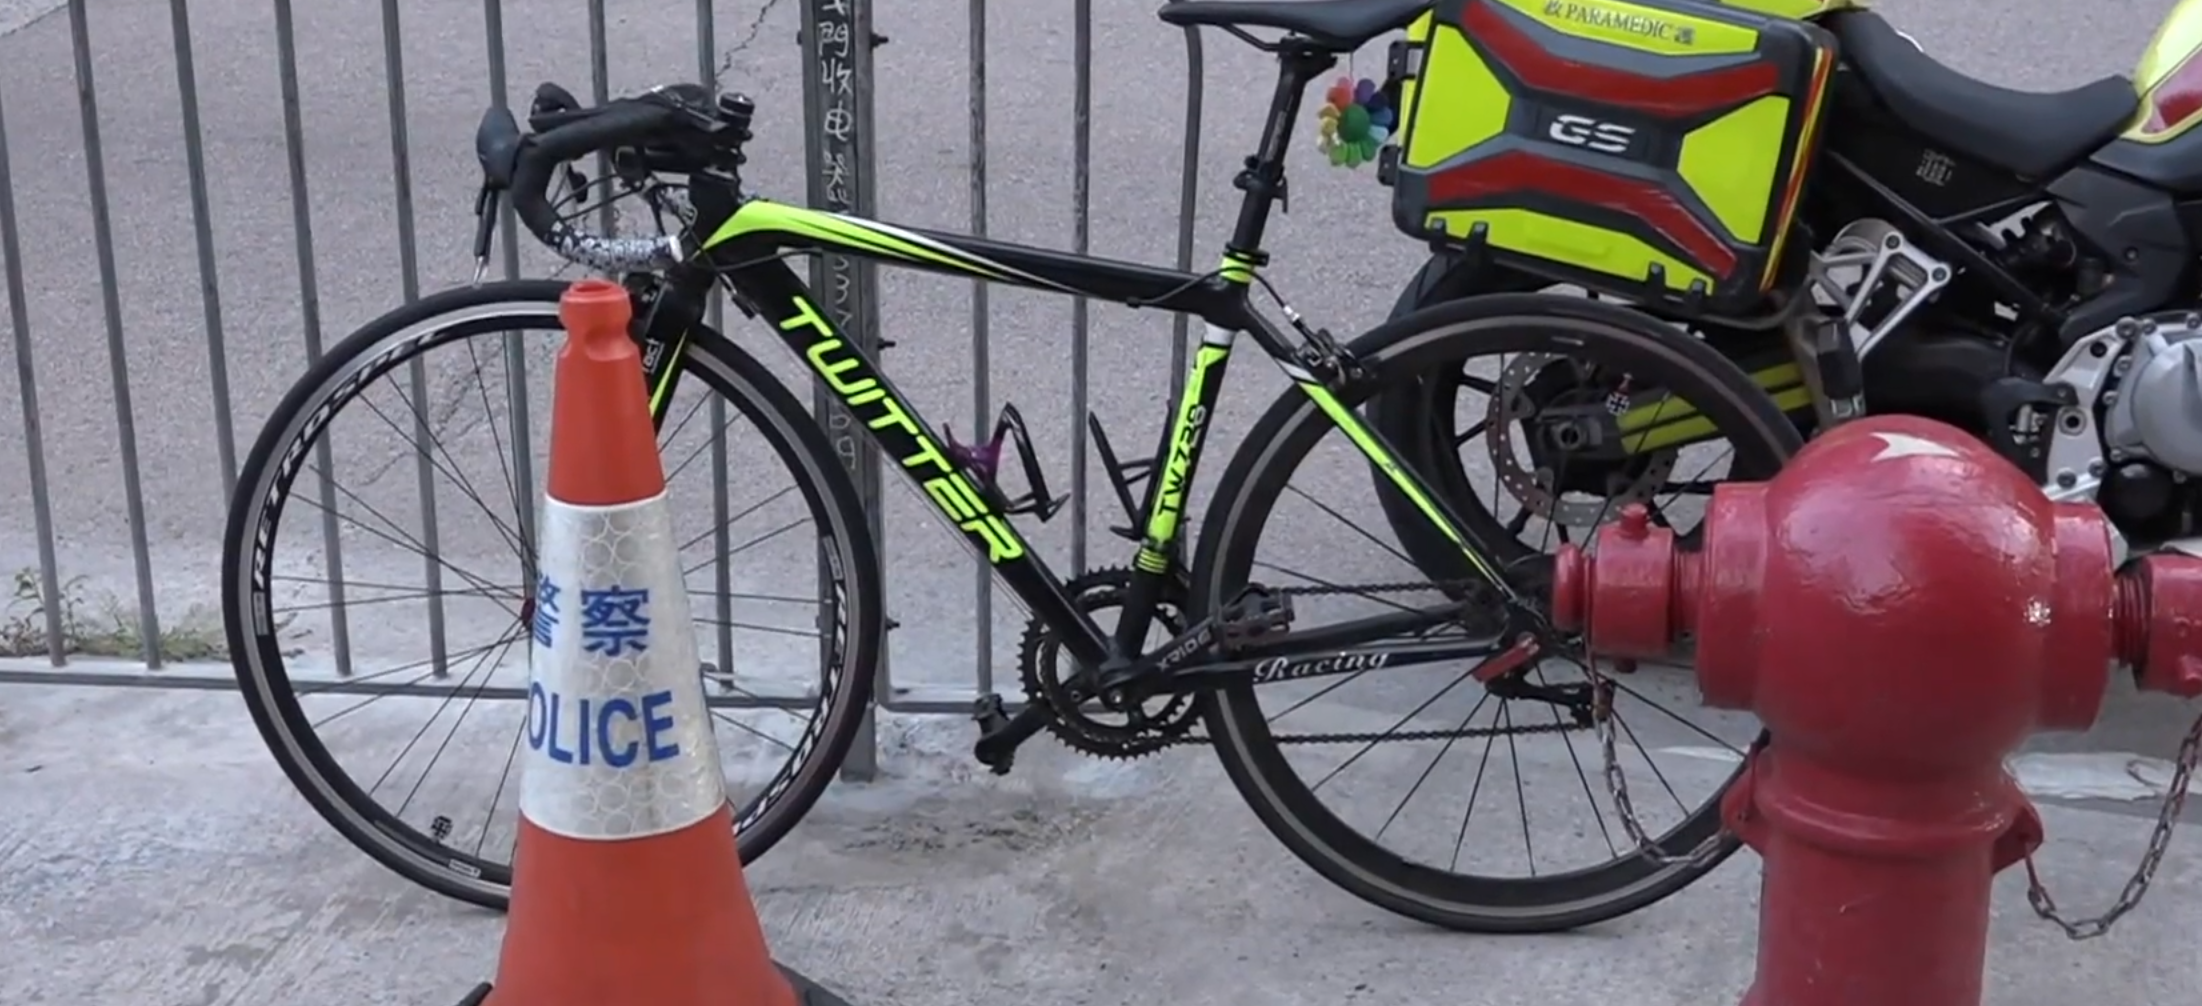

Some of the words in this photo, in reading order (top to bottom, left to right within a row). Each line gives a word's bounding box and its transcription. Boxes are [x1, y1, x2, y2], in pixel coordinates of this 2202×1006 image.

[1565, 3, 1674, 40] PARAMEDIC
[1549, 114, 1637, 153] GS
[779, 296, 1025, 563] TWITTER
[1252, 651, 1390, 683] Racing
[528, 681, 680, 768] OLICE
